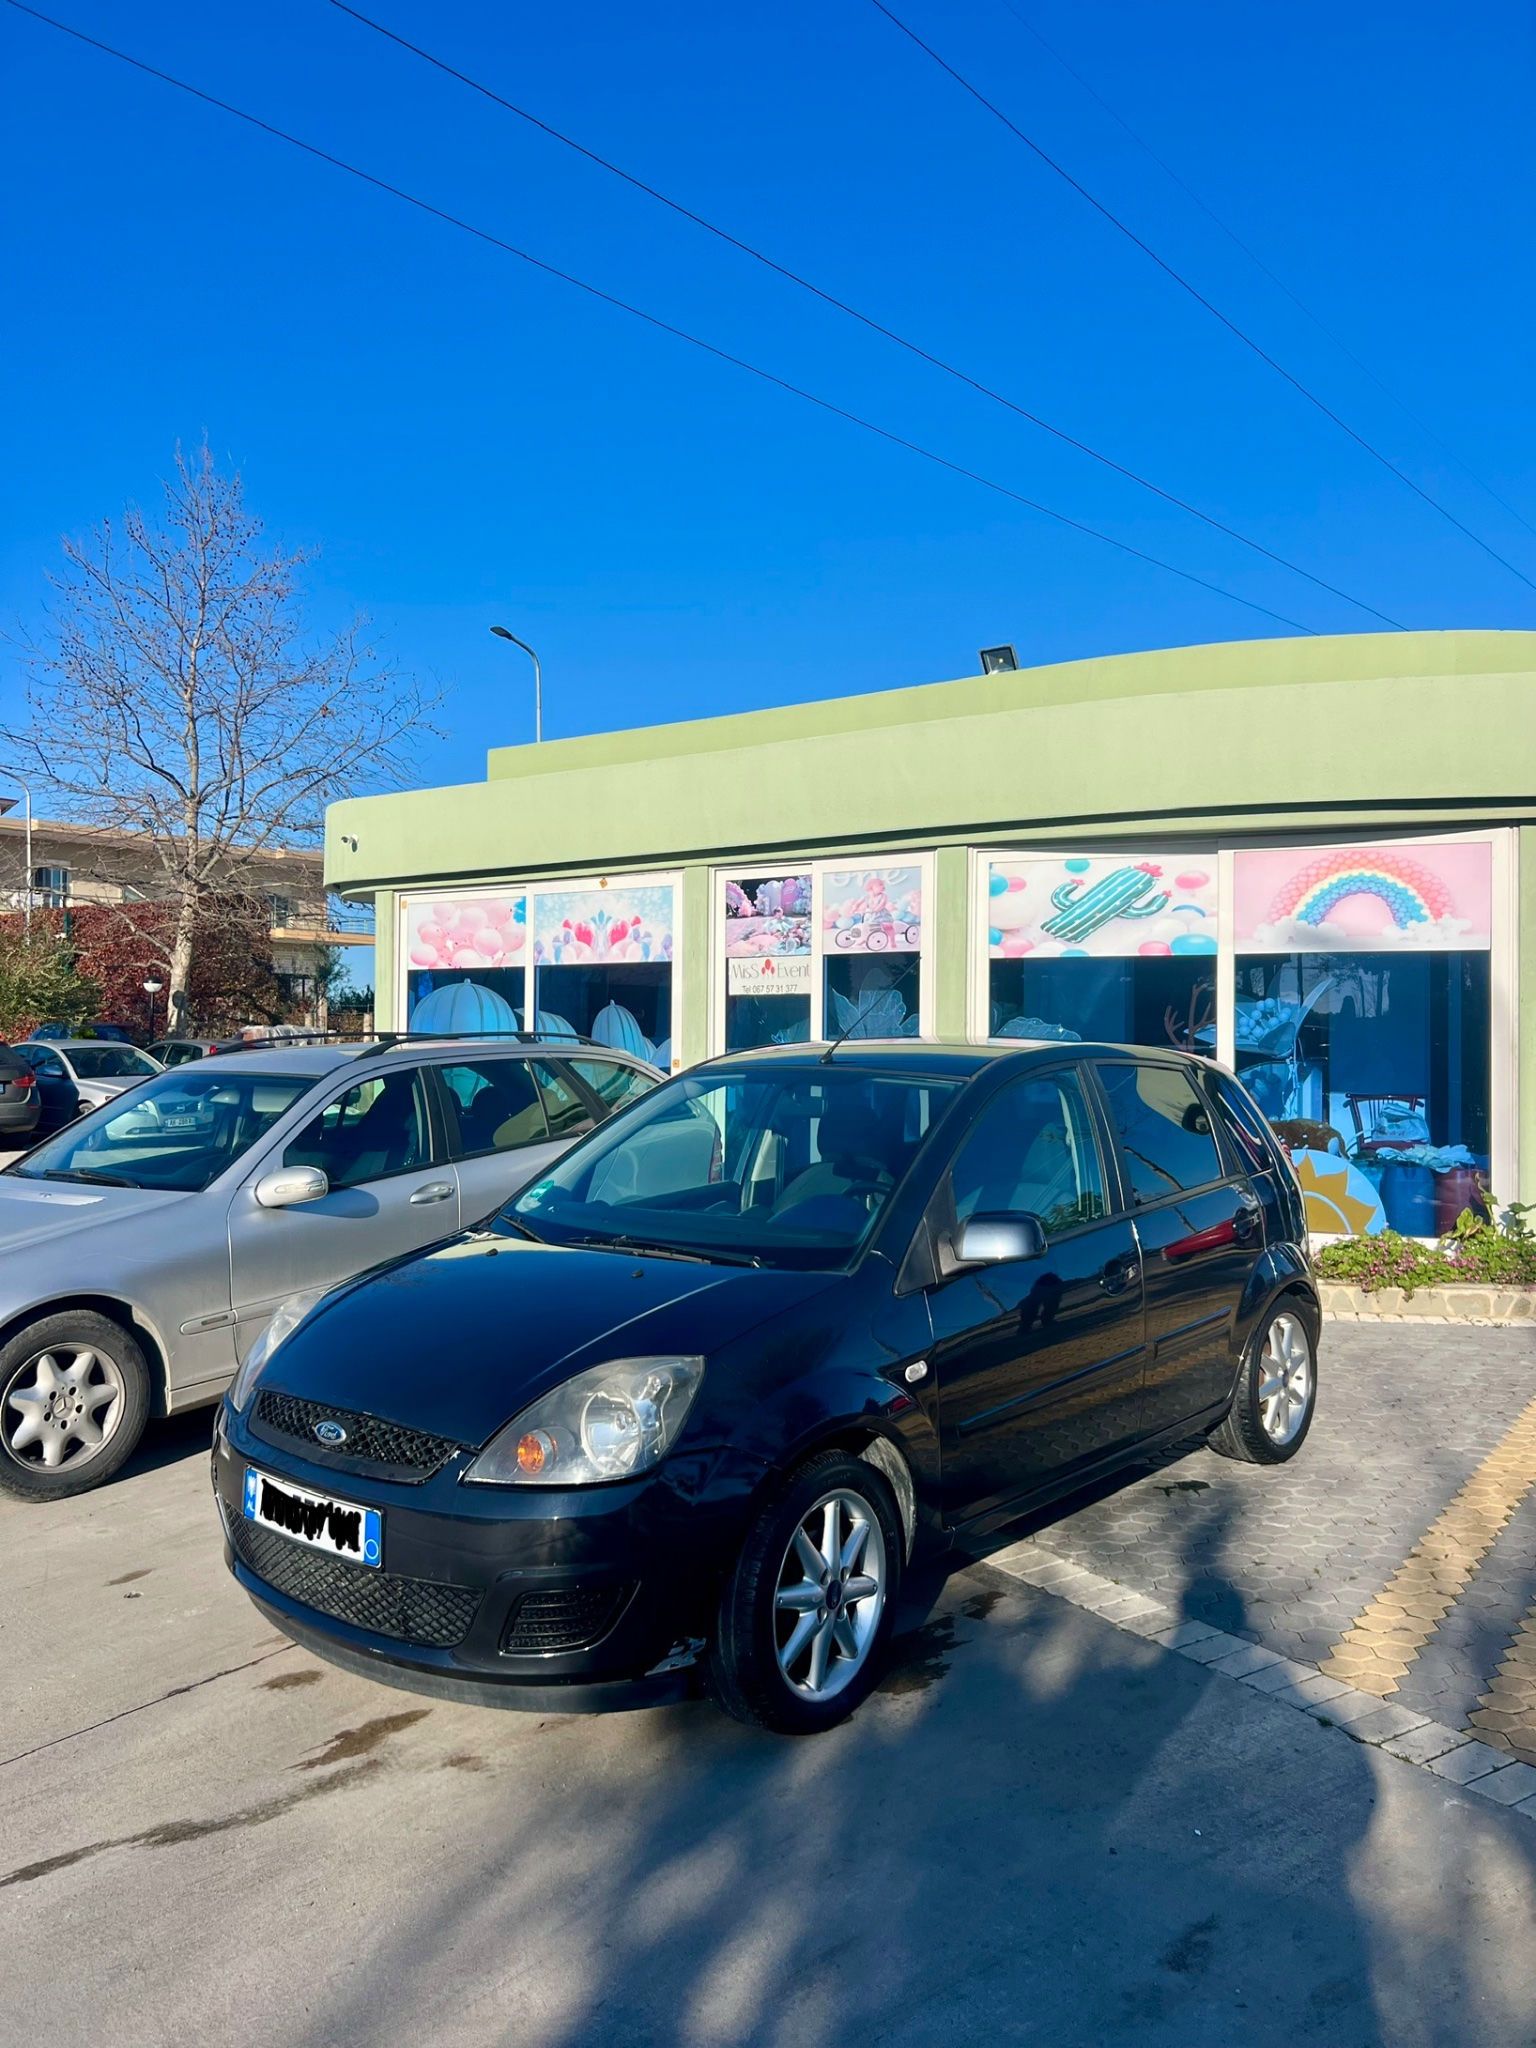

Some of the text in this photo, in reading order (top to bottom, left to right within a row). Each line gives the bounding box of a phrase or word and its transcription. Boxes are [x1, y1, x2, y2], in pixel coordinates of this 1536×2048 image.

[777, 963, 810, 978] Event
[765, 984, 775, 993] 57
[775, 984, 784, 993] 31
[320, 1424, 338, 1439] Ford
